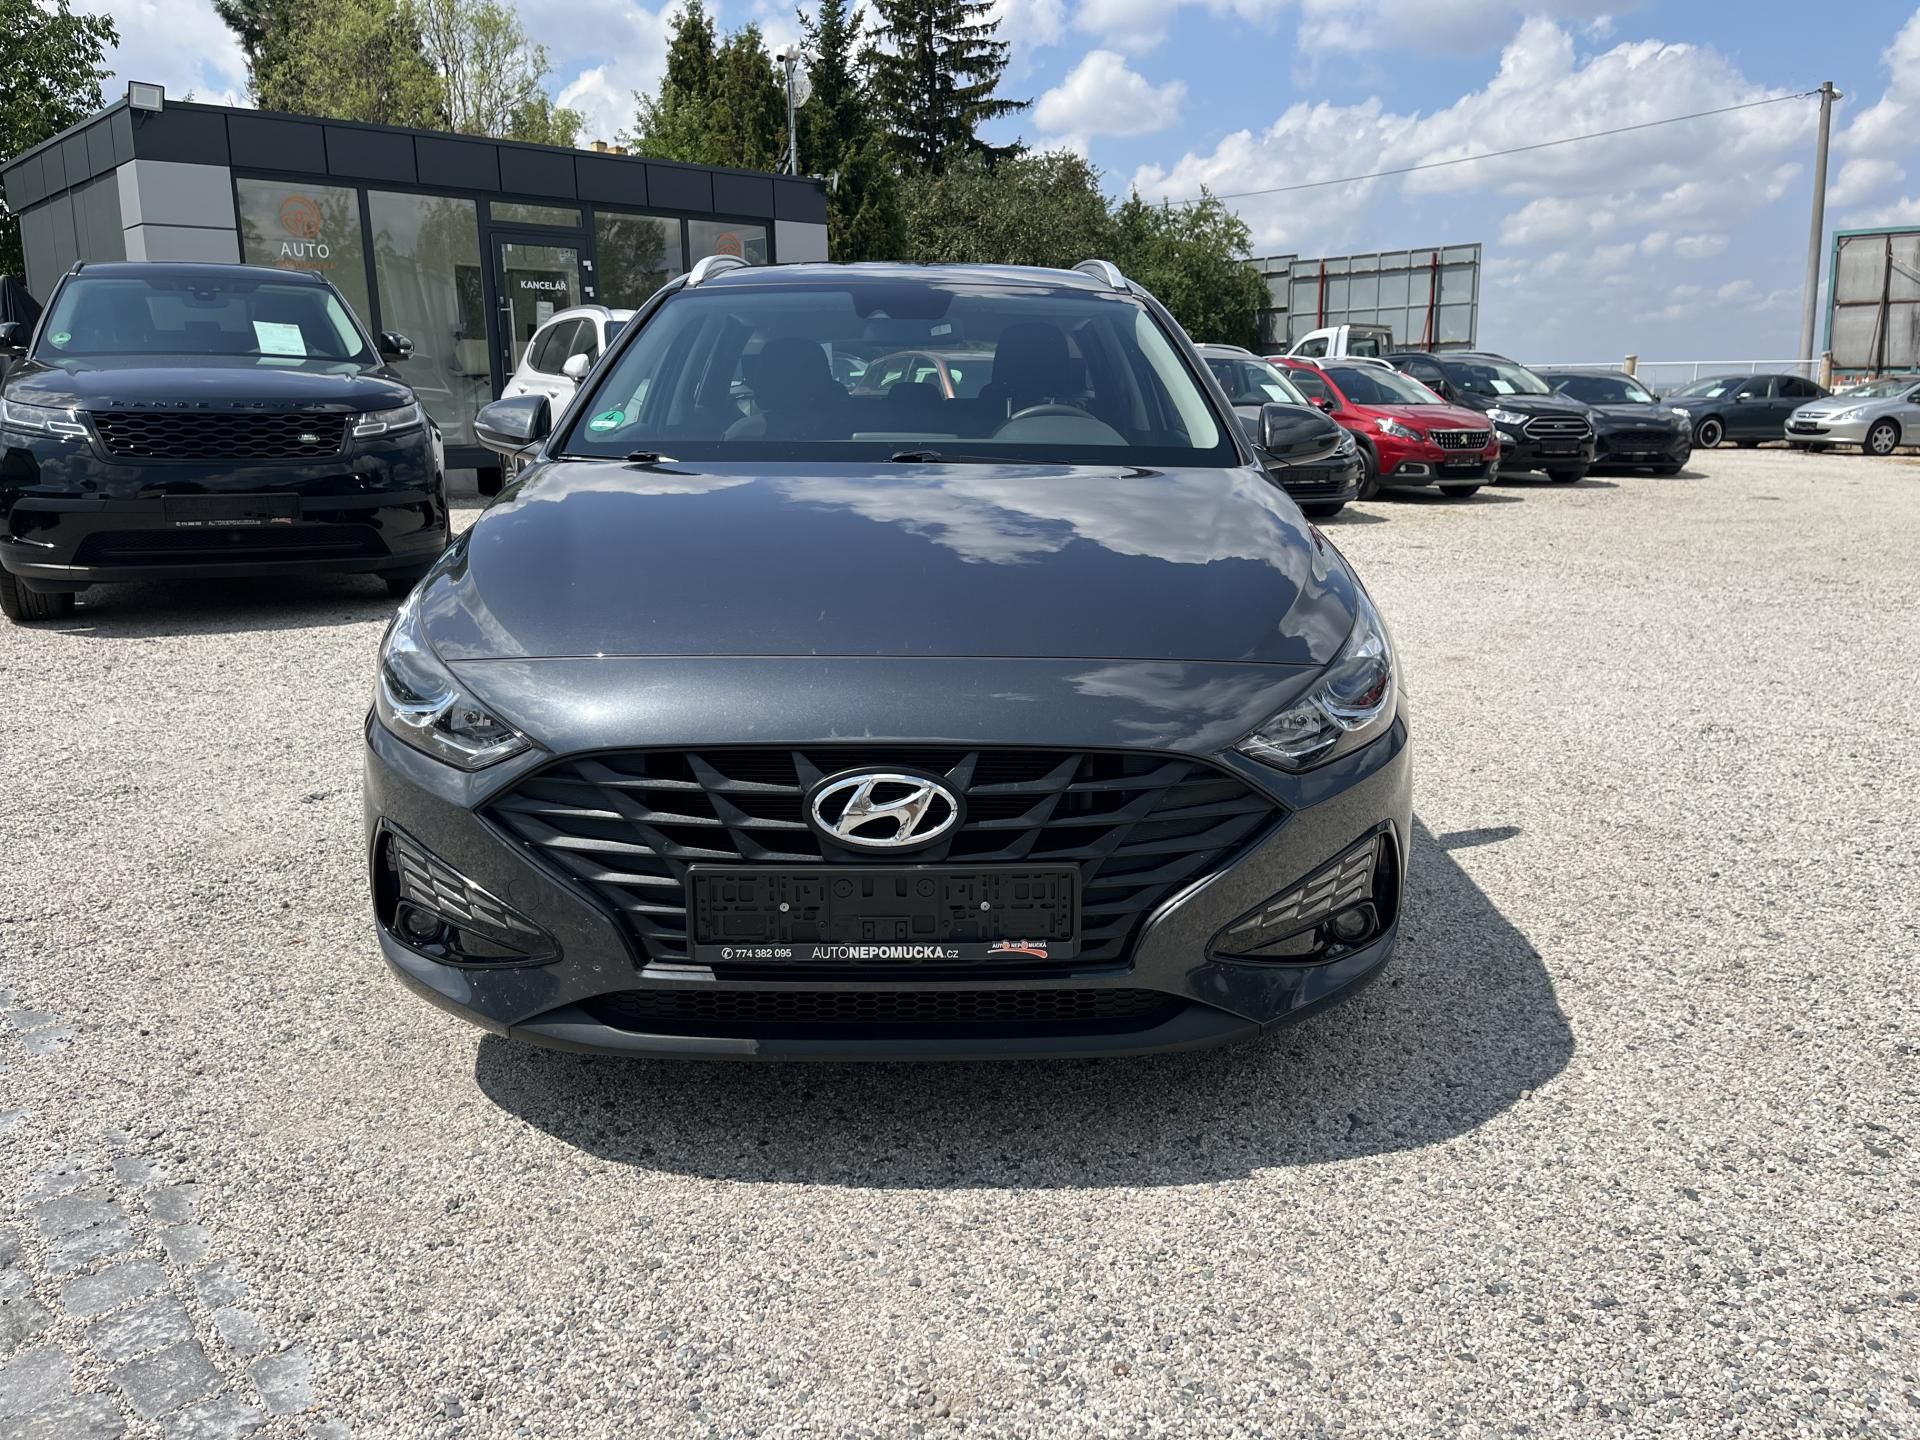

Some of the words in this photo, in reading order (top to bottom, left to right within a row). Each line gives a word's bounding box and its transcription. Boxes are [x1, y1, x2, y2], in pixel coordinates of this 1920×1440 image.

[281, 242, 330, 258] AUTO
[604, 411, 617, 421] 4
[735, 948, 753, 958] 774
[754, 948, 773, 958] 382
[774, 948, 792, 958] 095
